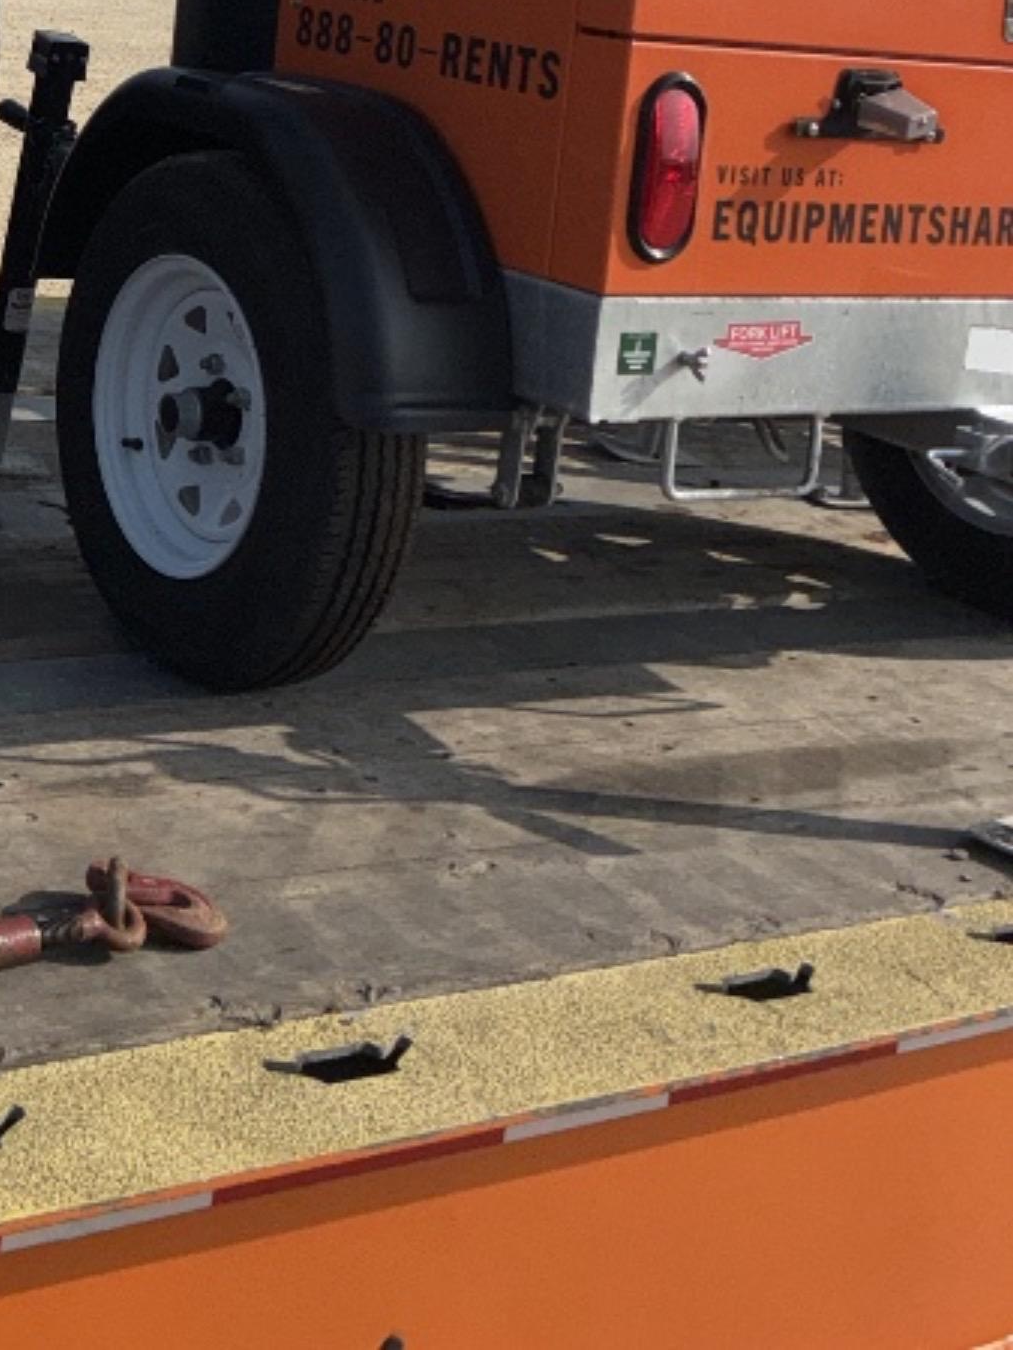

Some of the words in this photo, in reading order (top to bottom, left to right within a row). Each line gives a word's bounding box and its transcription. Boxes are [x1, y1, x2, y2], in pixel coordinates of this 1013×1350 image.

[296, 6, 561, 99] 888-80-RENTS
[716, 165, 771, 186] VISIT
[782, 166, 804, 187] US
[815, 168, 844, 187] AT:
[730, 326, 767, 340] FORK
